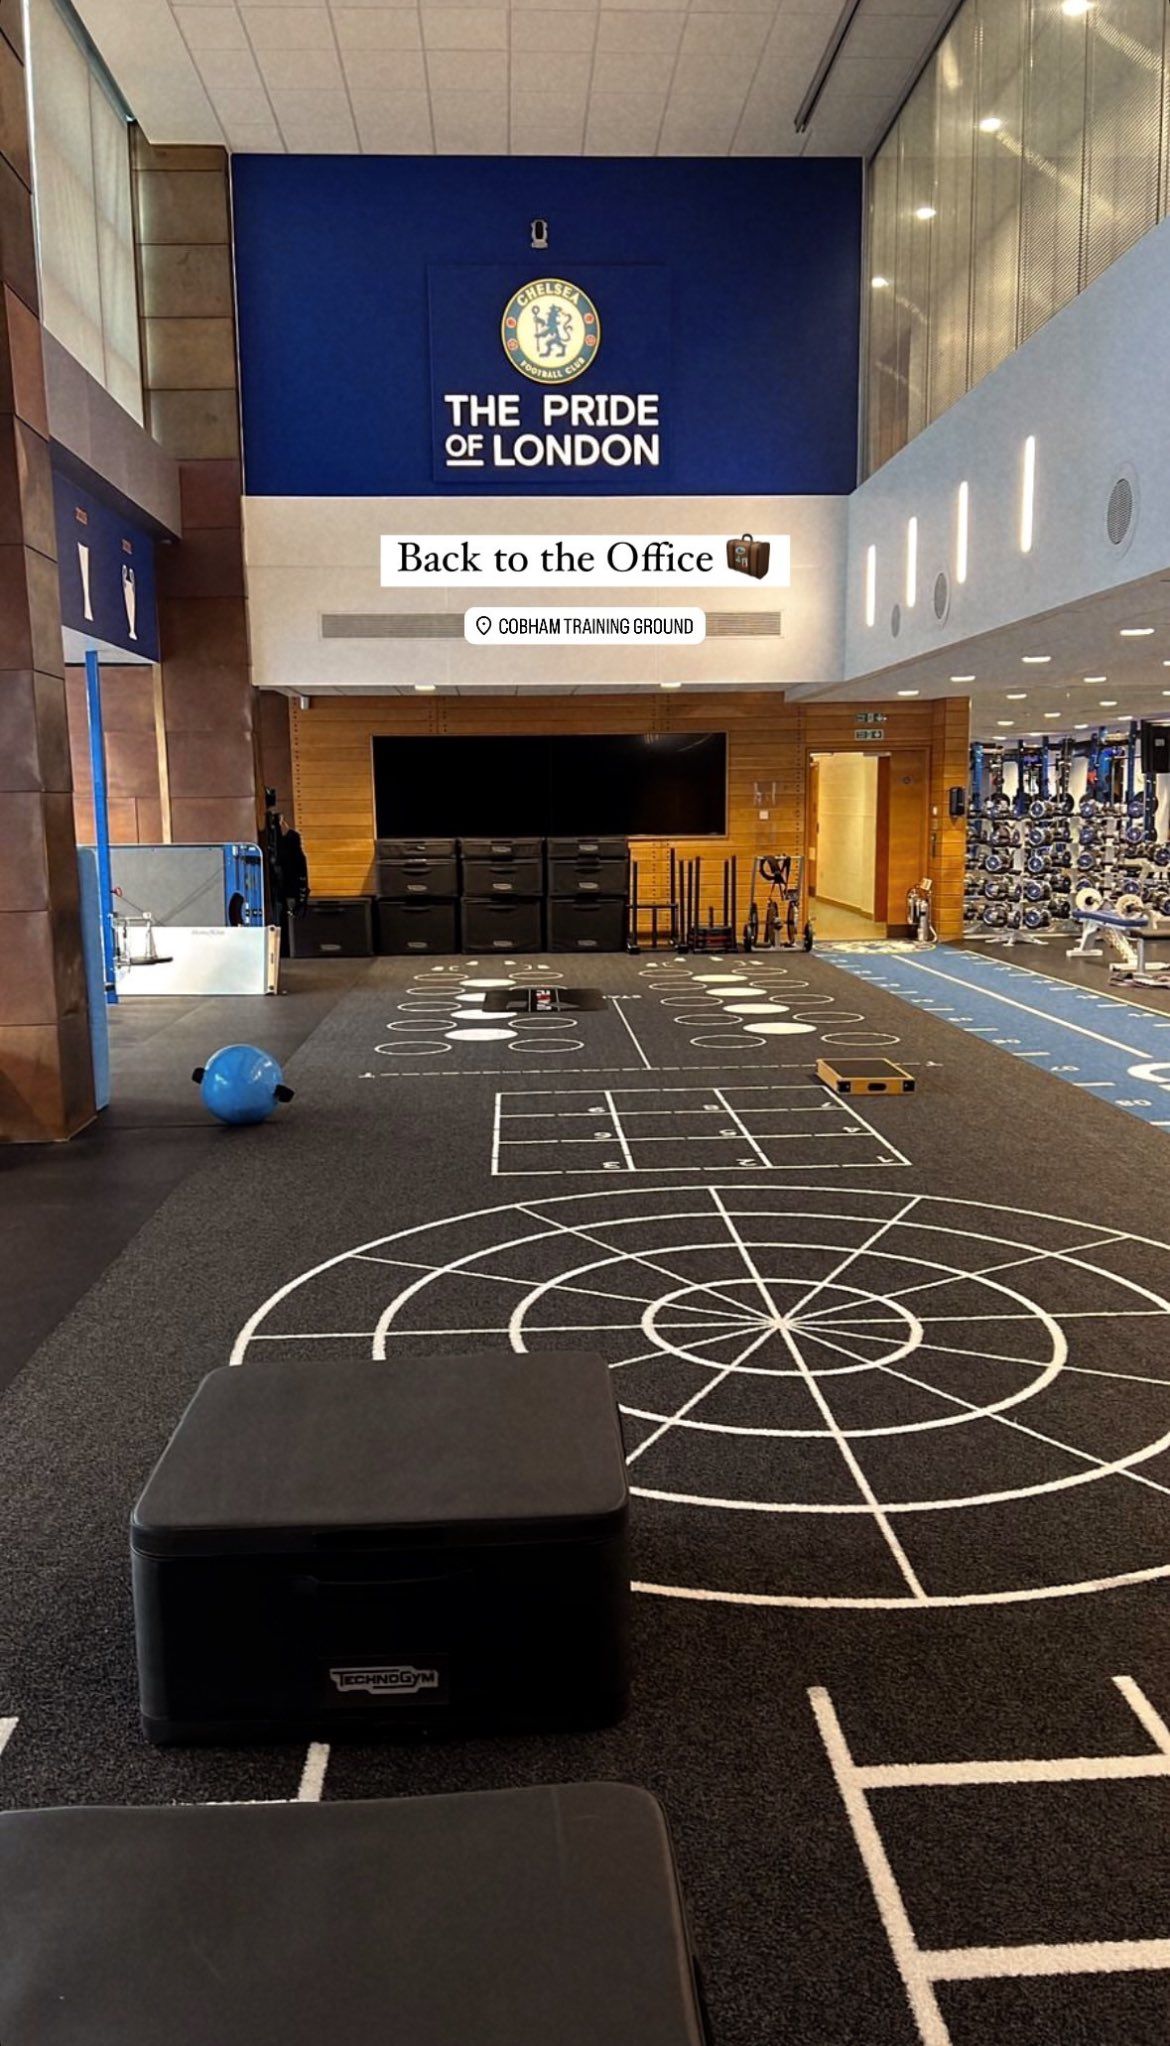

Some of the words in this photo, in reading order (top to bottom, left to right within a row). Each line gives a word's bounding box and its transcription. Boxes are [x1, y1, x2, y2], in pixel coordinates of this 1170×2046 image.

[517, 283, 580, 307] CHELSEA
[520, 360, 562, 378] FOOTBALL
[565, 357, 585, 374] CLUB
[445, 395, 520, 426] THE
[544, 395, 658, 426] PRIDE
[446, 434, 484, 460] OF
[494, 434, 659, 466] LONDON
